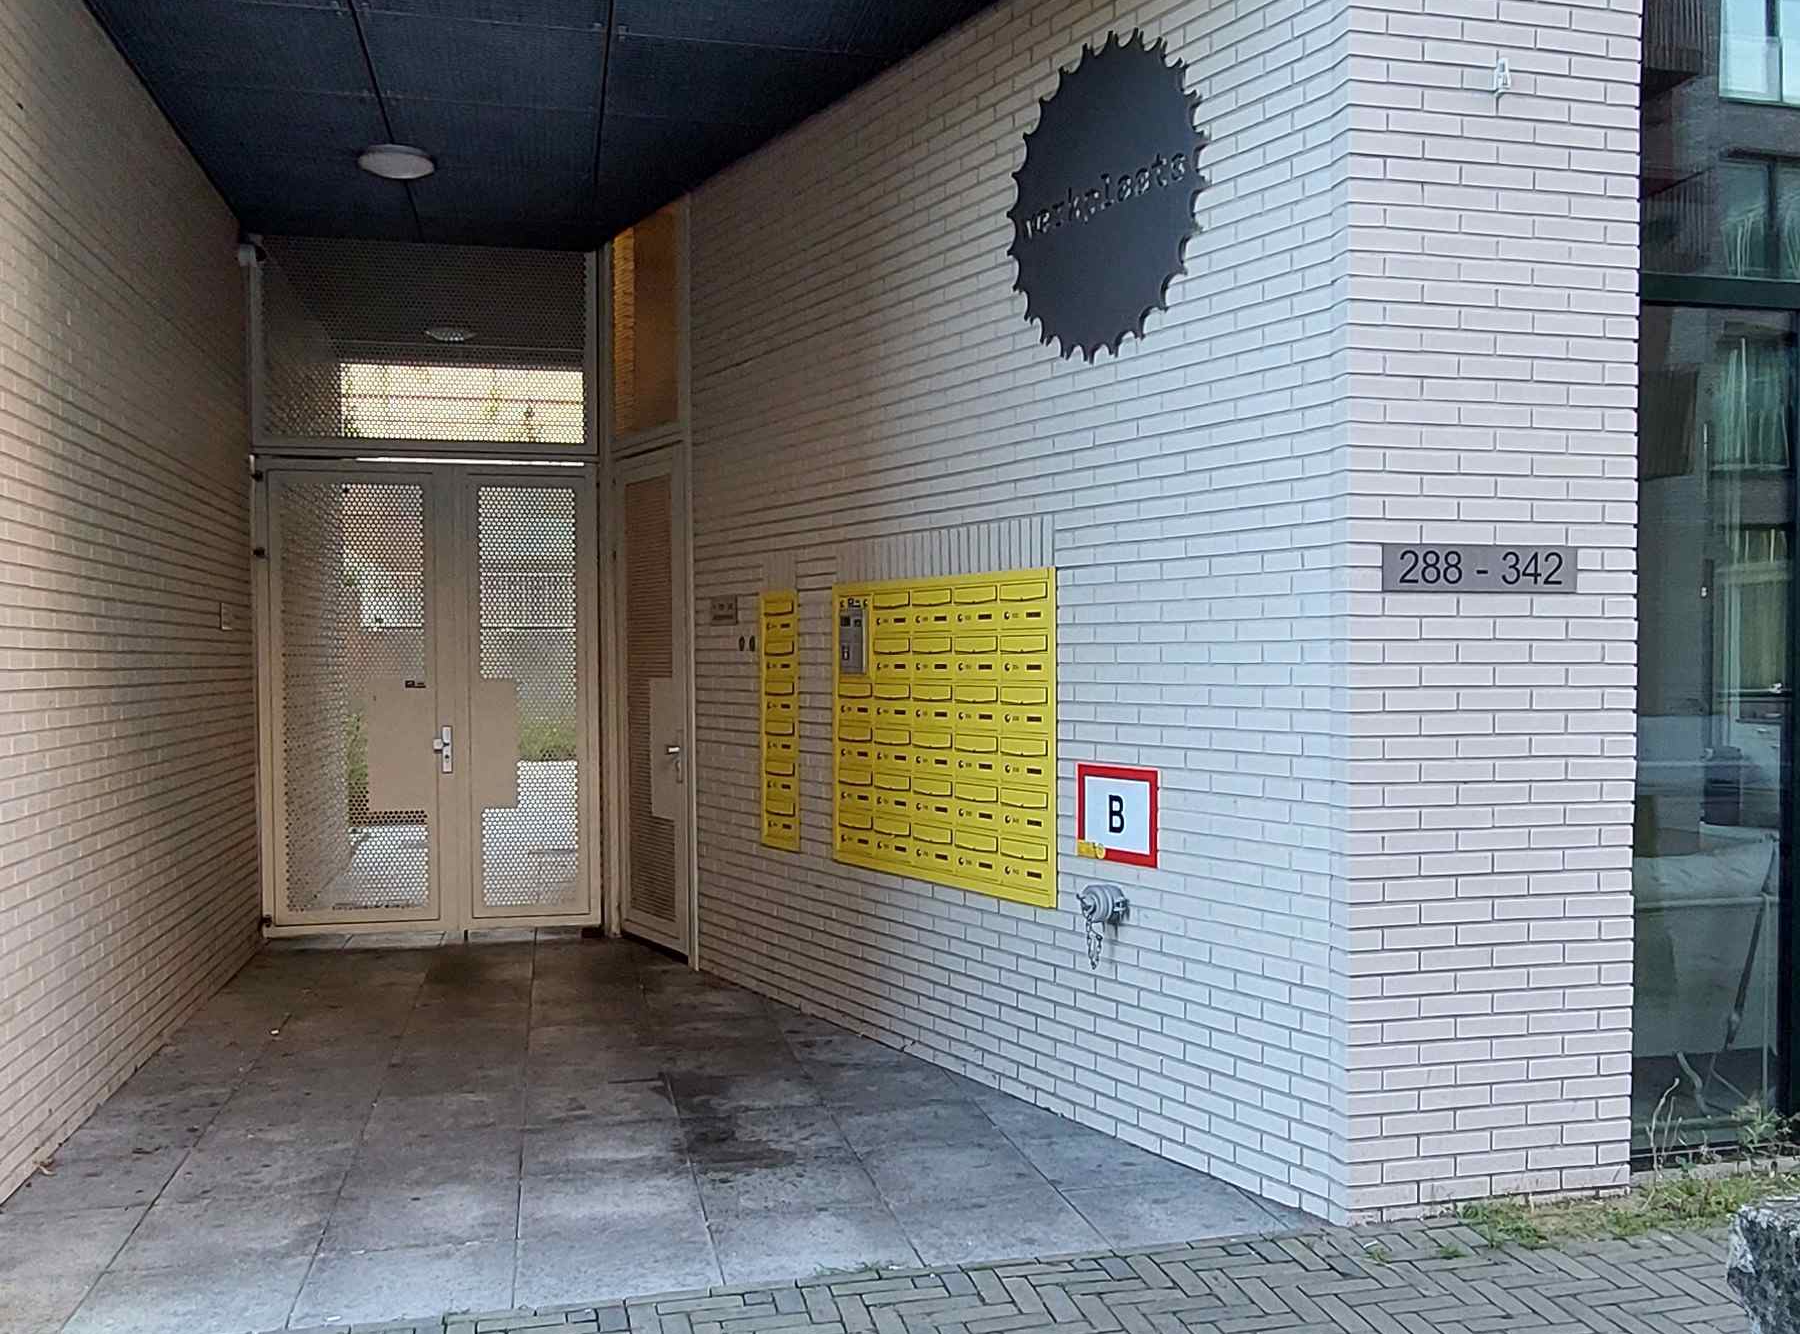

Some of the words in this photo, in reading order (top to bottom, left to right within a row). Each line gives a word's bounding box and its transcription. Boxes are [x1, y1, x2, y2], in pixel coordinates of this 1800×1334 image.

[1399, 550, 1462, 584] 288
[1501, 551, 1563, 585] 342
[1108, 794, 1125, 834] B
